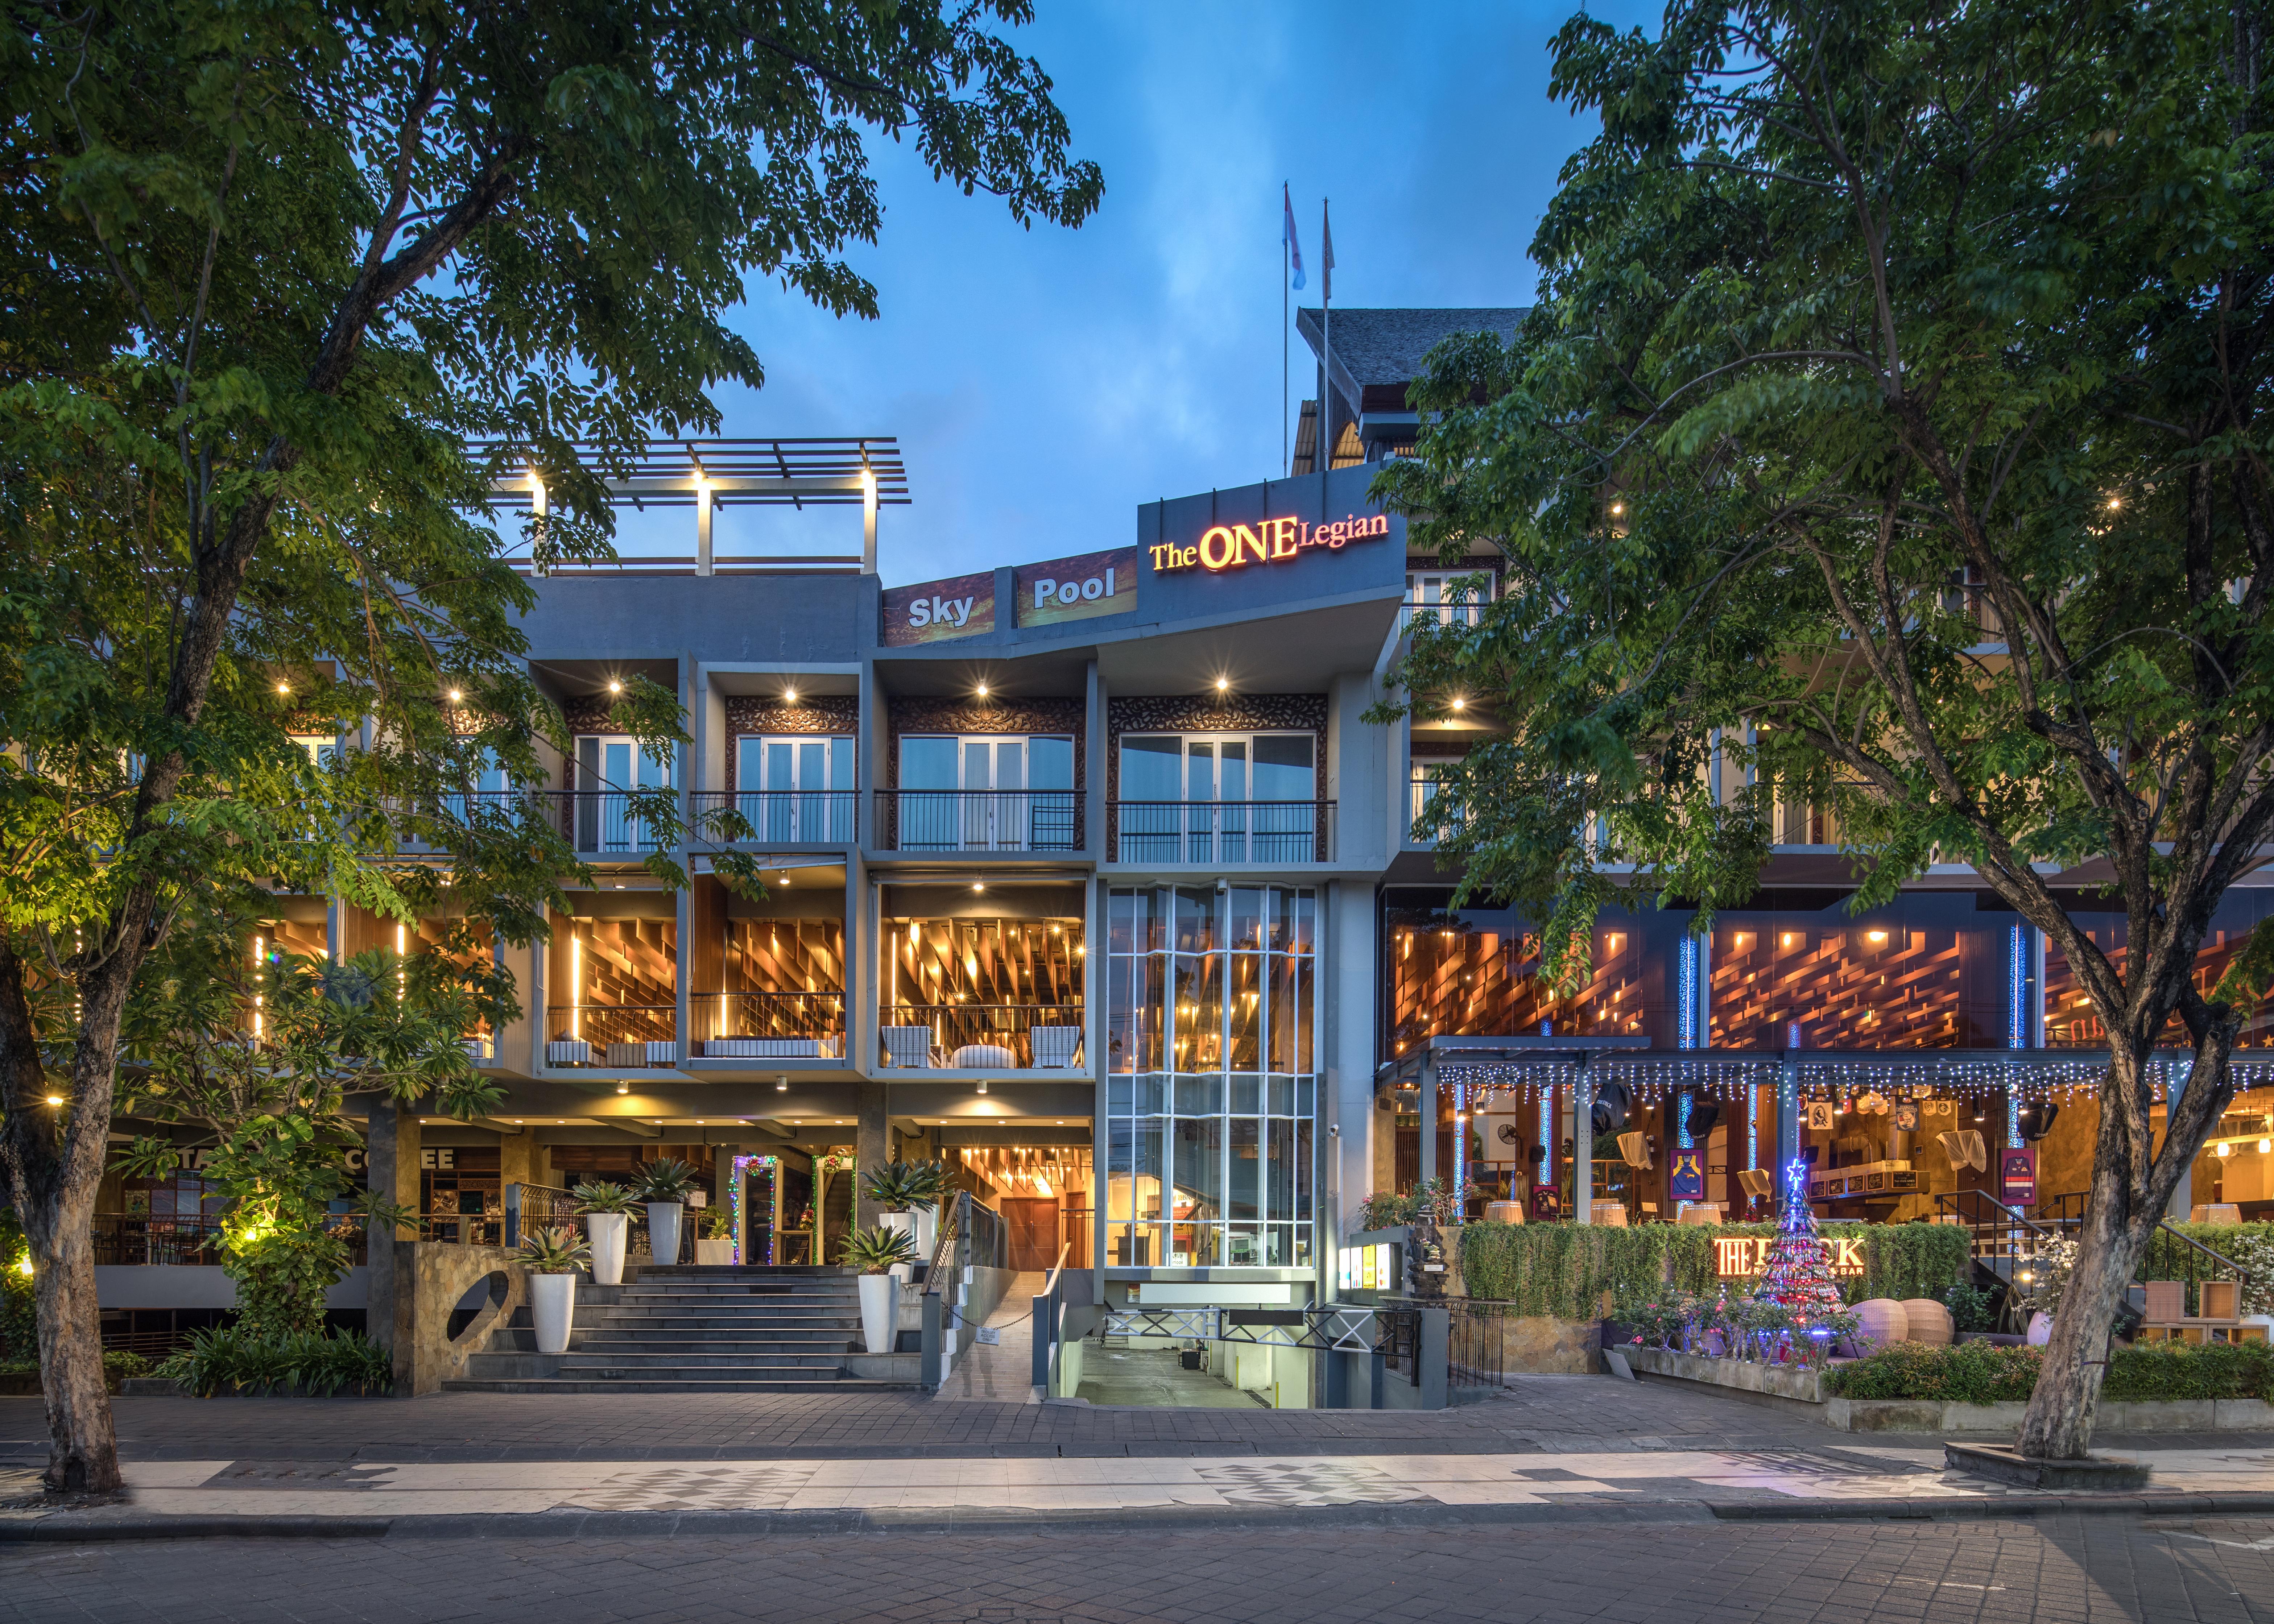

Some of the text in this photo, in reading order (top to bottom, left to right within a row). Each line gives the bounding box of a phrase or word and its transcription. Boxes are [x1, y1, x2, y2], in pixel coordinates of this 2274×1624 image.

[1149, 514, 1388, 571] The ONE Legian
[908, 567, 1115, 628] Sky Pool
[1714, 1239, 1753, 1275] THE
